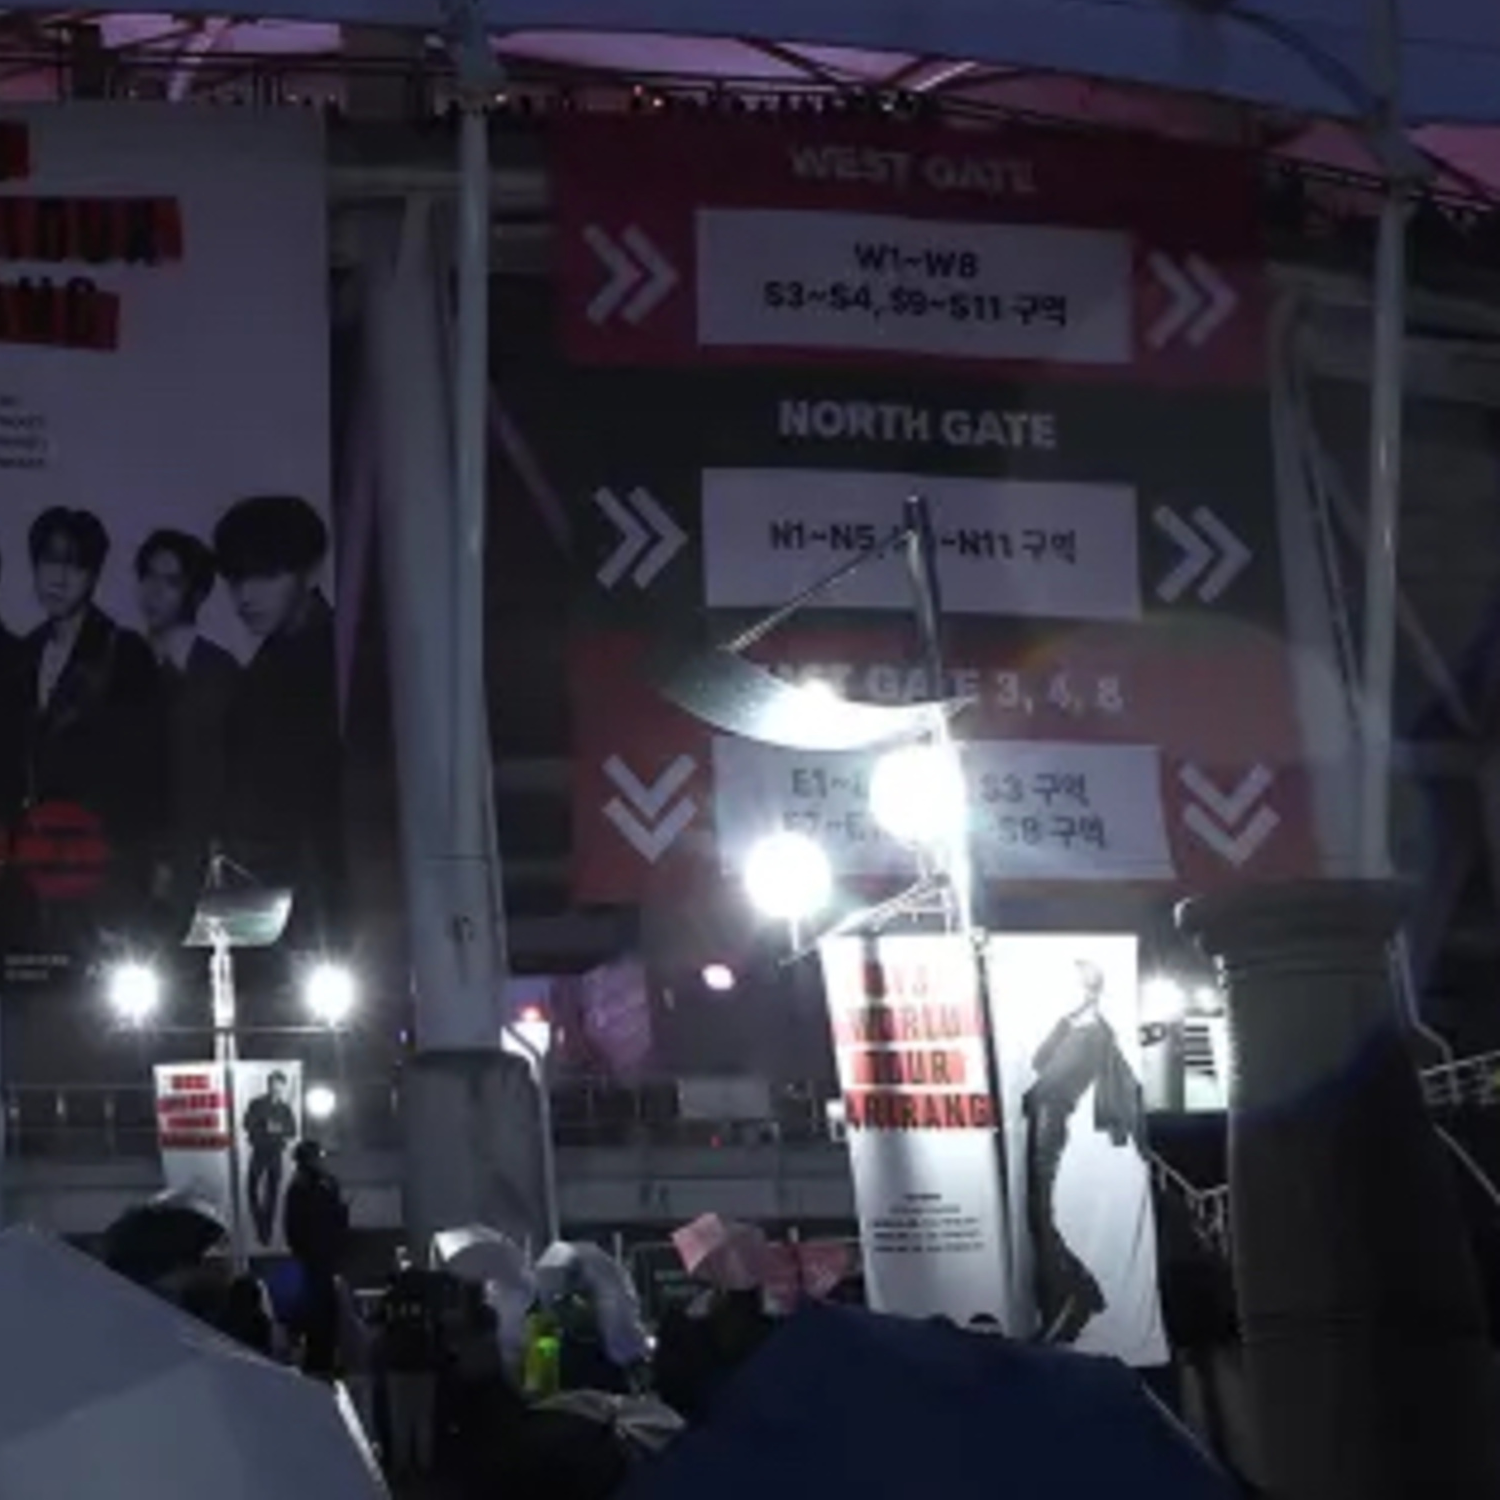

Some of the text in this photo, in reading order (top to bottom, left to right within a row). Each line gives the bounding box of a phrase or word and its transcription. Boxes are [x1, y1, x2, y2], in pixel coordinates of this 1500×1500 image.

[790, 142, 1038, 195] WEST GATE
[854, 242, 982, 280] W1~W8
[1011, 294, 1069, 329] 구역
[775, 398, 1058, 447] NORTH GATE
[1021, 527, 1078, 565] 구역
[1030, 771, 1092, 808] 구역
[1049, 812, 1109, 851] 구역
